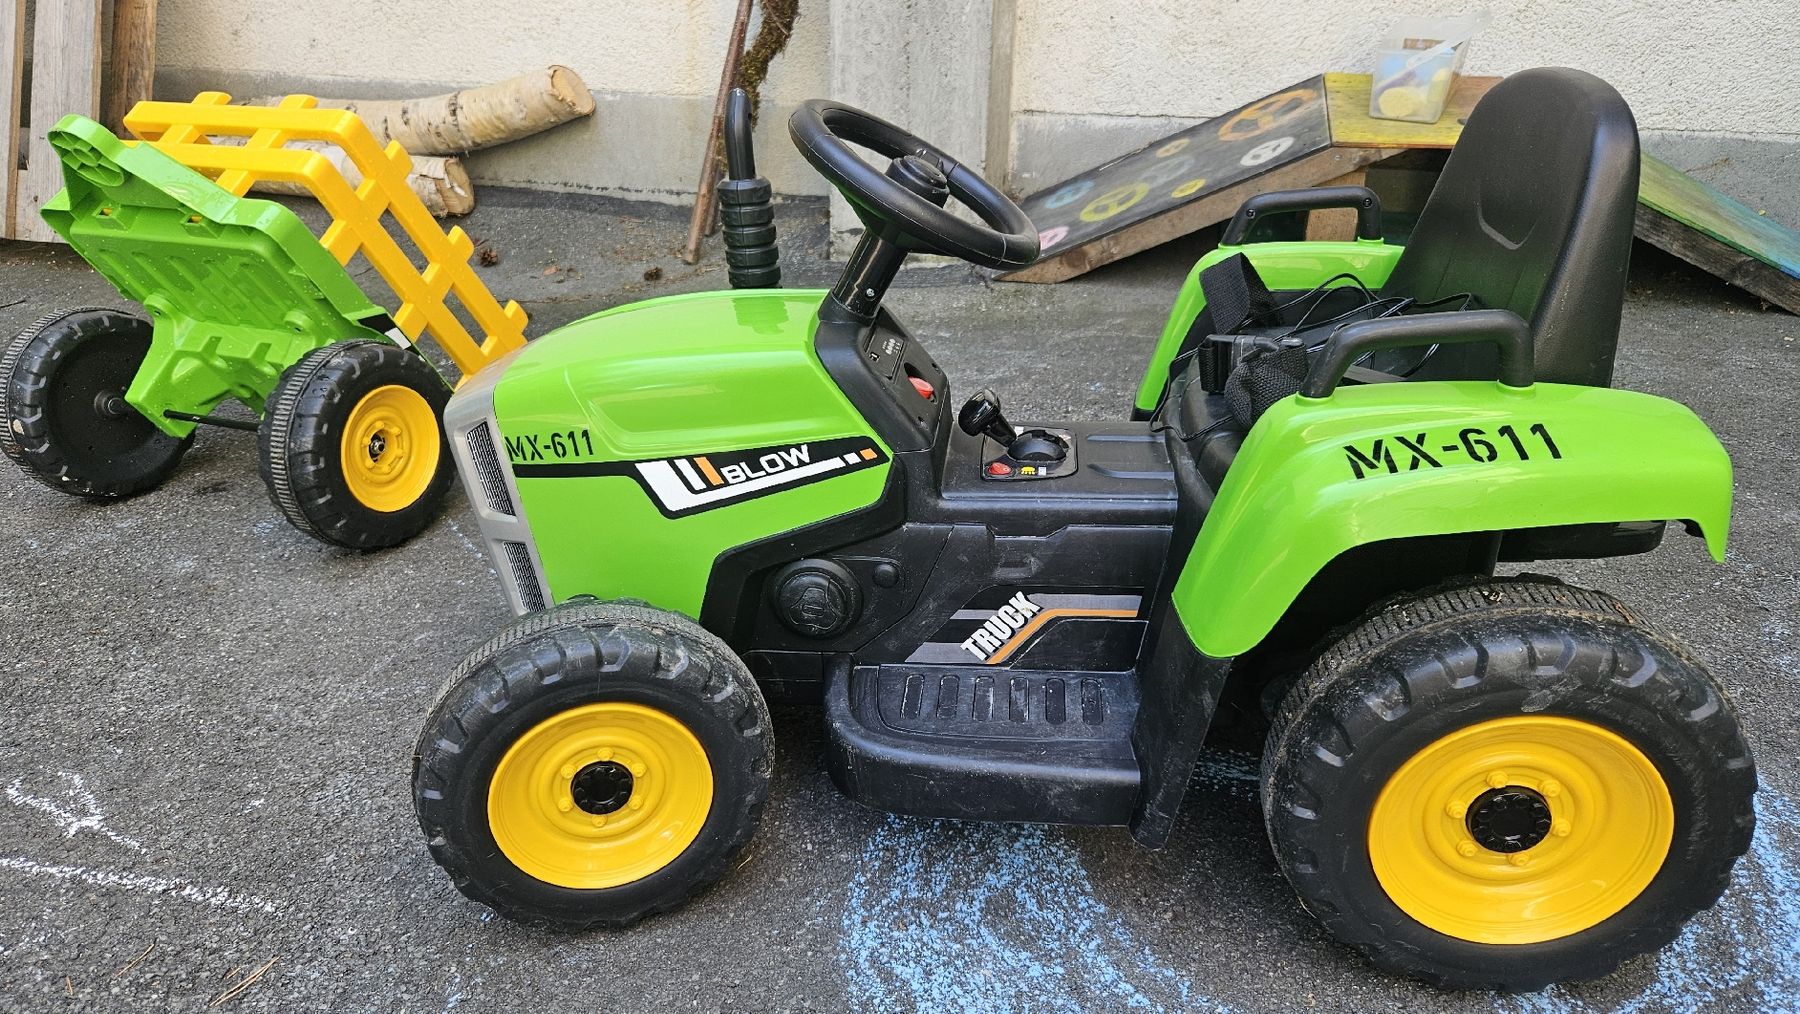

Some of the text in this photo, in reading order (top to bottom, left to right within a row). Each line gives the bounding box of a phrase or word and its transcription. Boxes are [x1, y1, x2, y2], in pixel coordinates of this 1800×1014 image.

[504, 429, 594, 461] MX-611
[720, 444, 810, 484] BLOW
[1343, 423, 1562, 479] MX-611
[960, 591, 1040, 661] TRUCK
